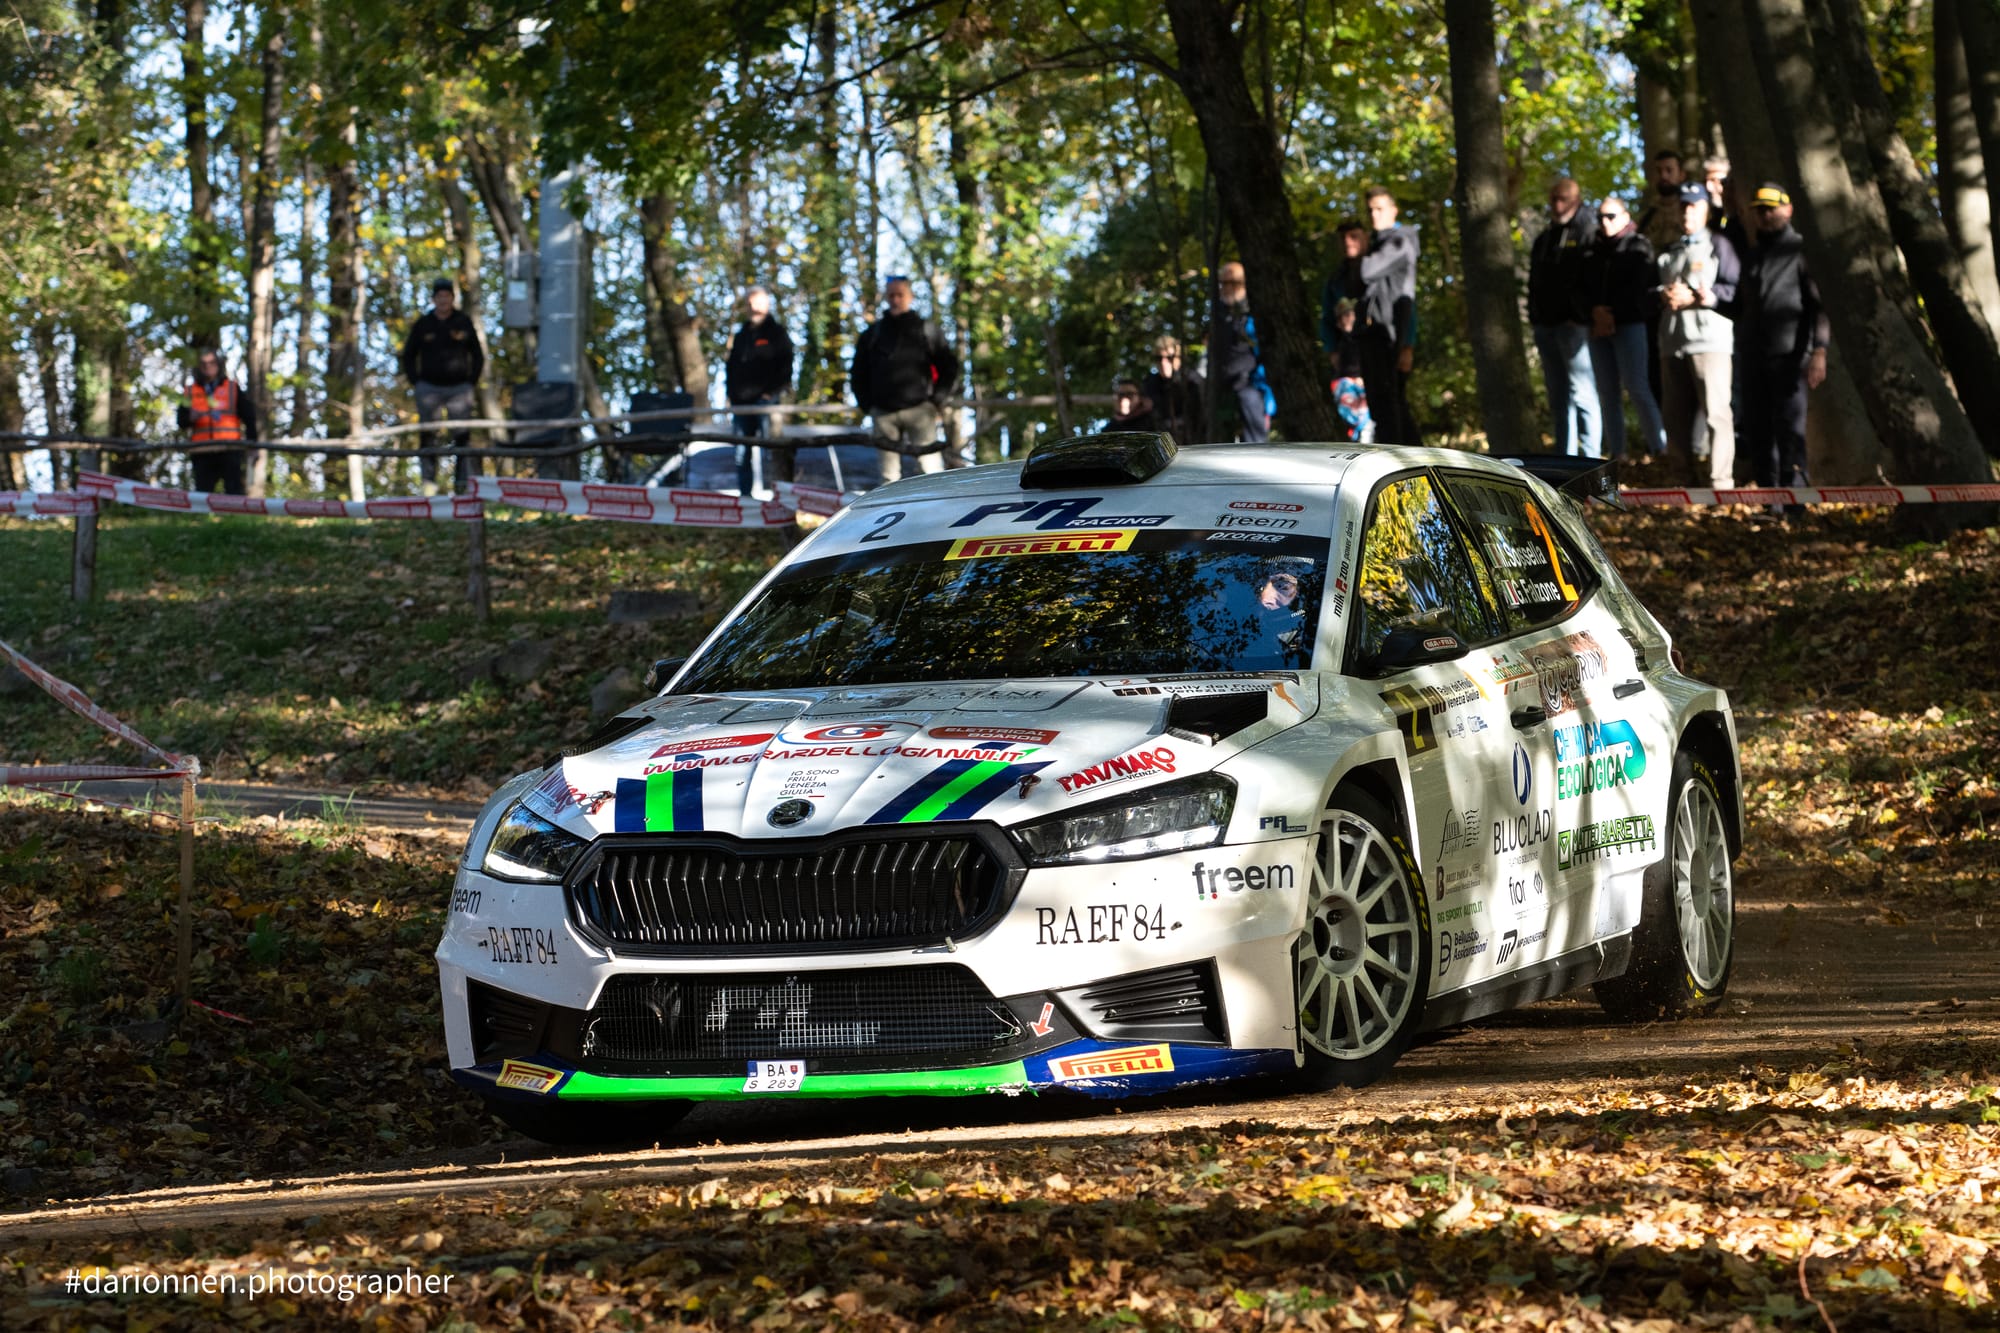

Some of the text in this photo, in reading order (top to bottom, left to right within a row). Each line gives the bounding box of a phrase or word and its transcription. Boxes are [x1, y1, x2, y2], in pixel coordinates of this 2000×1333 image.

[860, 511, 906, 543] 2
[1066, 517, 1160, 527] RACING
[1215, 513, 1299, 529] freem
[957, 532, 1124, 558] PIRELLI
[1206, 531, 1286, 542] prorace
[1334, 592, 1345, 618] milk
[1394, 691, 1425, 750] 2
[668, 737, 733, 750] QUADRI
[967, 732, 1044, 742] BOARDS
[1553, 721, 1607, 763] CHIMICA
[784, 781, 828, 789] VENEZIA
[1126, 769, 1157, 780] VICENZA
[1557, 753, 1627, 800] ECOLOGICA
[779, 788, 814, 796] GIULIA
[1493, 809, 1551, 855] BLUCLAD
[1192, 861, 1294, 896] freem
[453, 887, 482, 914] reem
[1133, 903, 1166, 942] 84
[536, 928, 559, 965] 84
[767, 1063, 786, 1077] BA
[1060, 1046, 1163, 1078] PIRELLI
[501, 1063, 557, 1090] PIRELLI
[767, 1079, 797, 1089] 283
